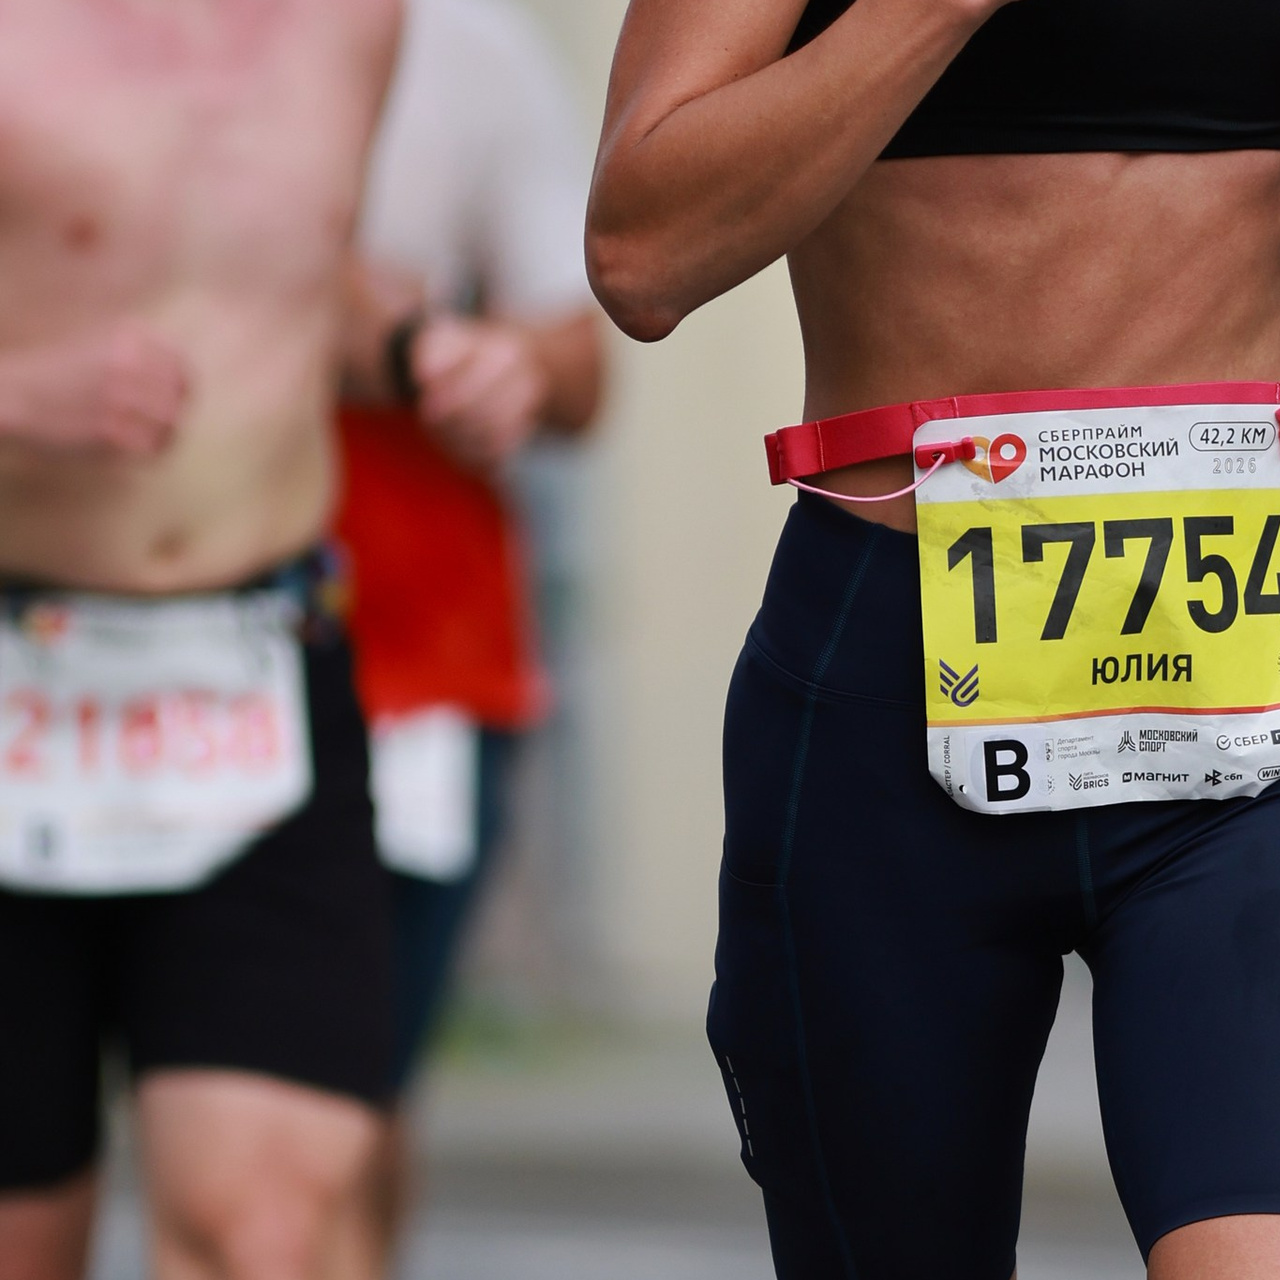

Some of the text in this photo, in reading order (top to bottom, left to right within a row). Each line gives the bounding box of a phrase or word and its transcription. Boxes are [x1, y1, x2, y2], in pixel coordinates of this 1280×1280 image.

[1038, 424, 1142, 443] СБЕРПРАЙМ
[1200, 428, 1235, 447] 42,2
[1039, 438, 1179, 462] МОСКОВСКИЙ
[1040, 461, 1145, 482] МАРАФОН
[1213, 457, 1257, 474] 2026
[1092, 653, 1192, 685] ЮЛИЯ
[1139, 729, 1198, 742] МОСКОВСКИЙ
[1234, 734, 1268, 747] СБЕР
[943, 735, 951, 764] CORRAL
[1139, 741, 1167, 752] СПОРТ
[1083, 778, 1109, 790] BRICS
